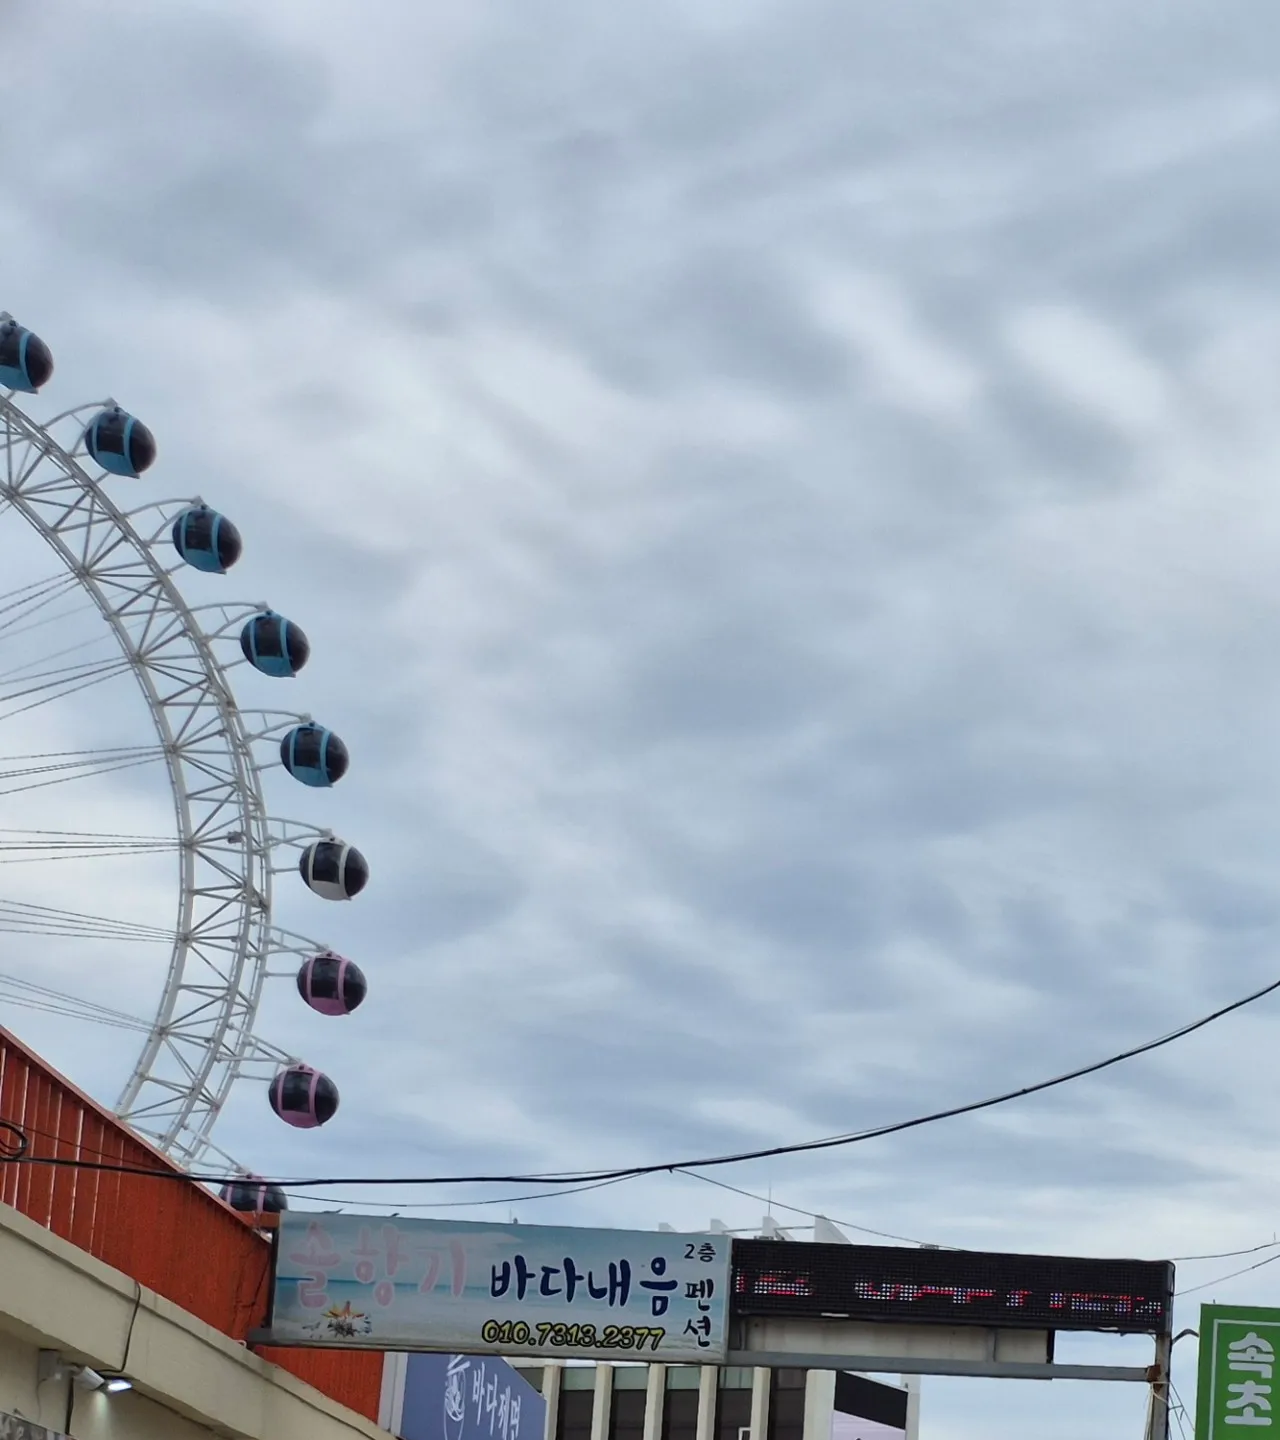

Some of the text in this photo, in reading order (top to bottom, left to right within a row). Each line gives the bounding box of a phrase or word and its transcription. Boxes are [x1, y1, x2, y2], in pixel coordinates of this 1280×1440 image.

[289, 1220, 466, 1309] 솔향기
[490, 1254, 678, 1316] 바다내음
[684, 1242, 716, 1263] 2층
[482, 1319, 666, 1351] 010.7313.2377
[683, 1278, 714, 1348] 펜션
[1224, 1331, 1275, 1426] 속초
